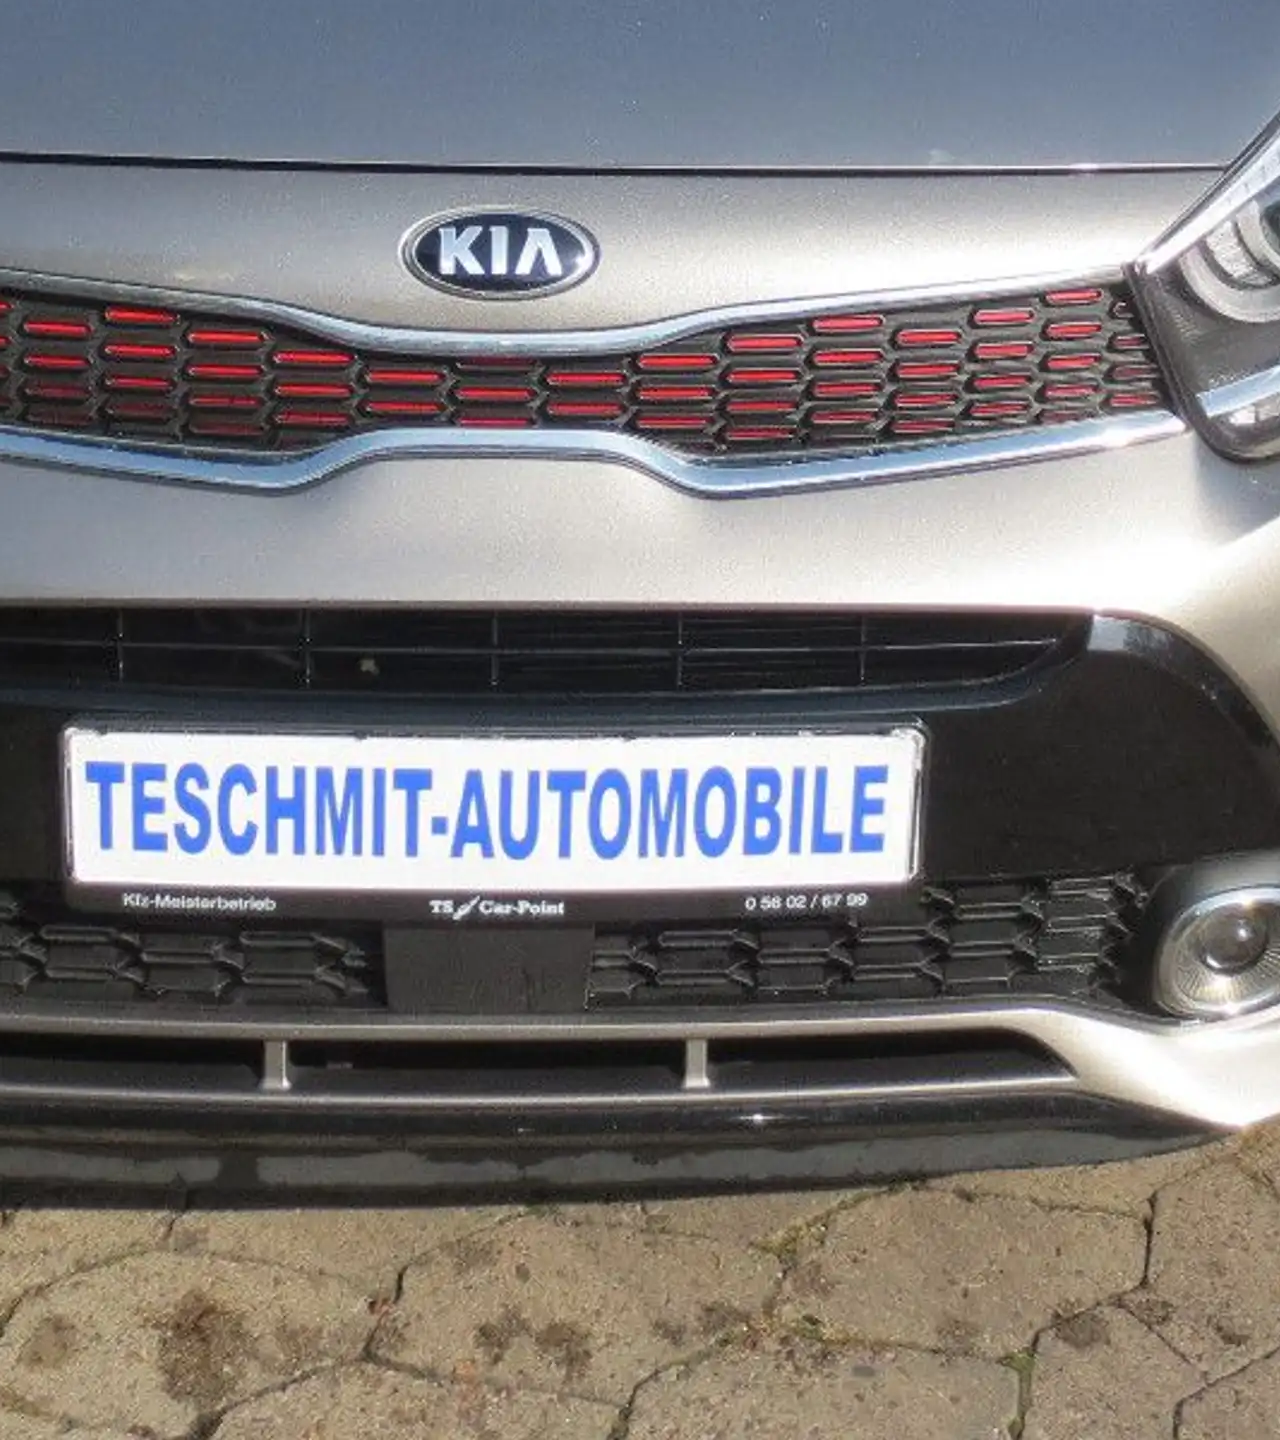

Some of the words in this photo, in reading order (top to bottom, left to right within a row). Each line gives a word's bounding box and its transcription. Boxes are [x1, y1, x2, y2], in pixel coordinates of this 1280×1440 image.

[438, 225, 563, 276] KIA
[84, 761, 891, 861] TESCHMIT-AUTOMOBILE
[122, 892, 277, 911] Kfz-Meisterbetrieb
[478, 899, 566, 915] Car-Point
